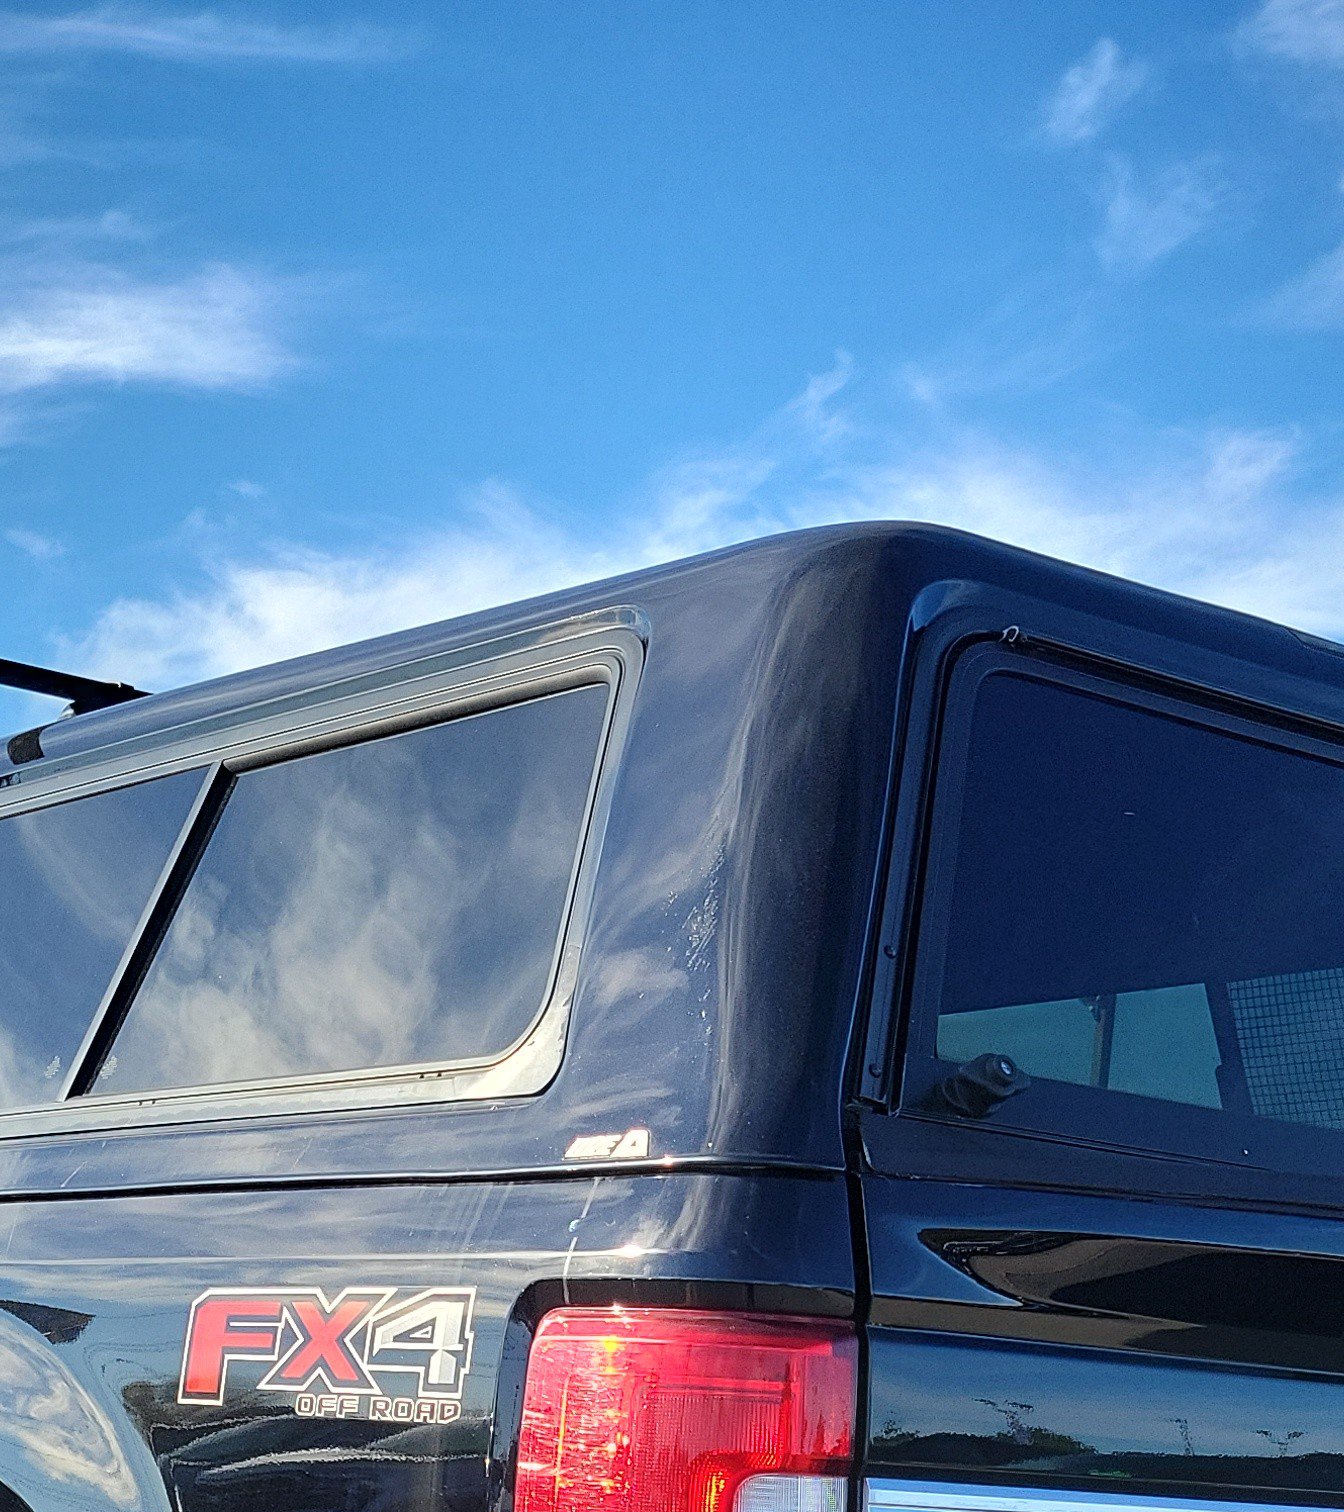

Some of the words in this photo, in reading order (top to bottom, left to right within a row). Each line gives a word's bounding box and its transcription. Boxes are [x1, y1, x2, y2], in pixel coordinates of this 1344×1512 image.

[177, 1286, 475, 1405] FX4
[295, 1393, 360, 1419] OFF
[369, 1397, 462, 1424] ROAD
